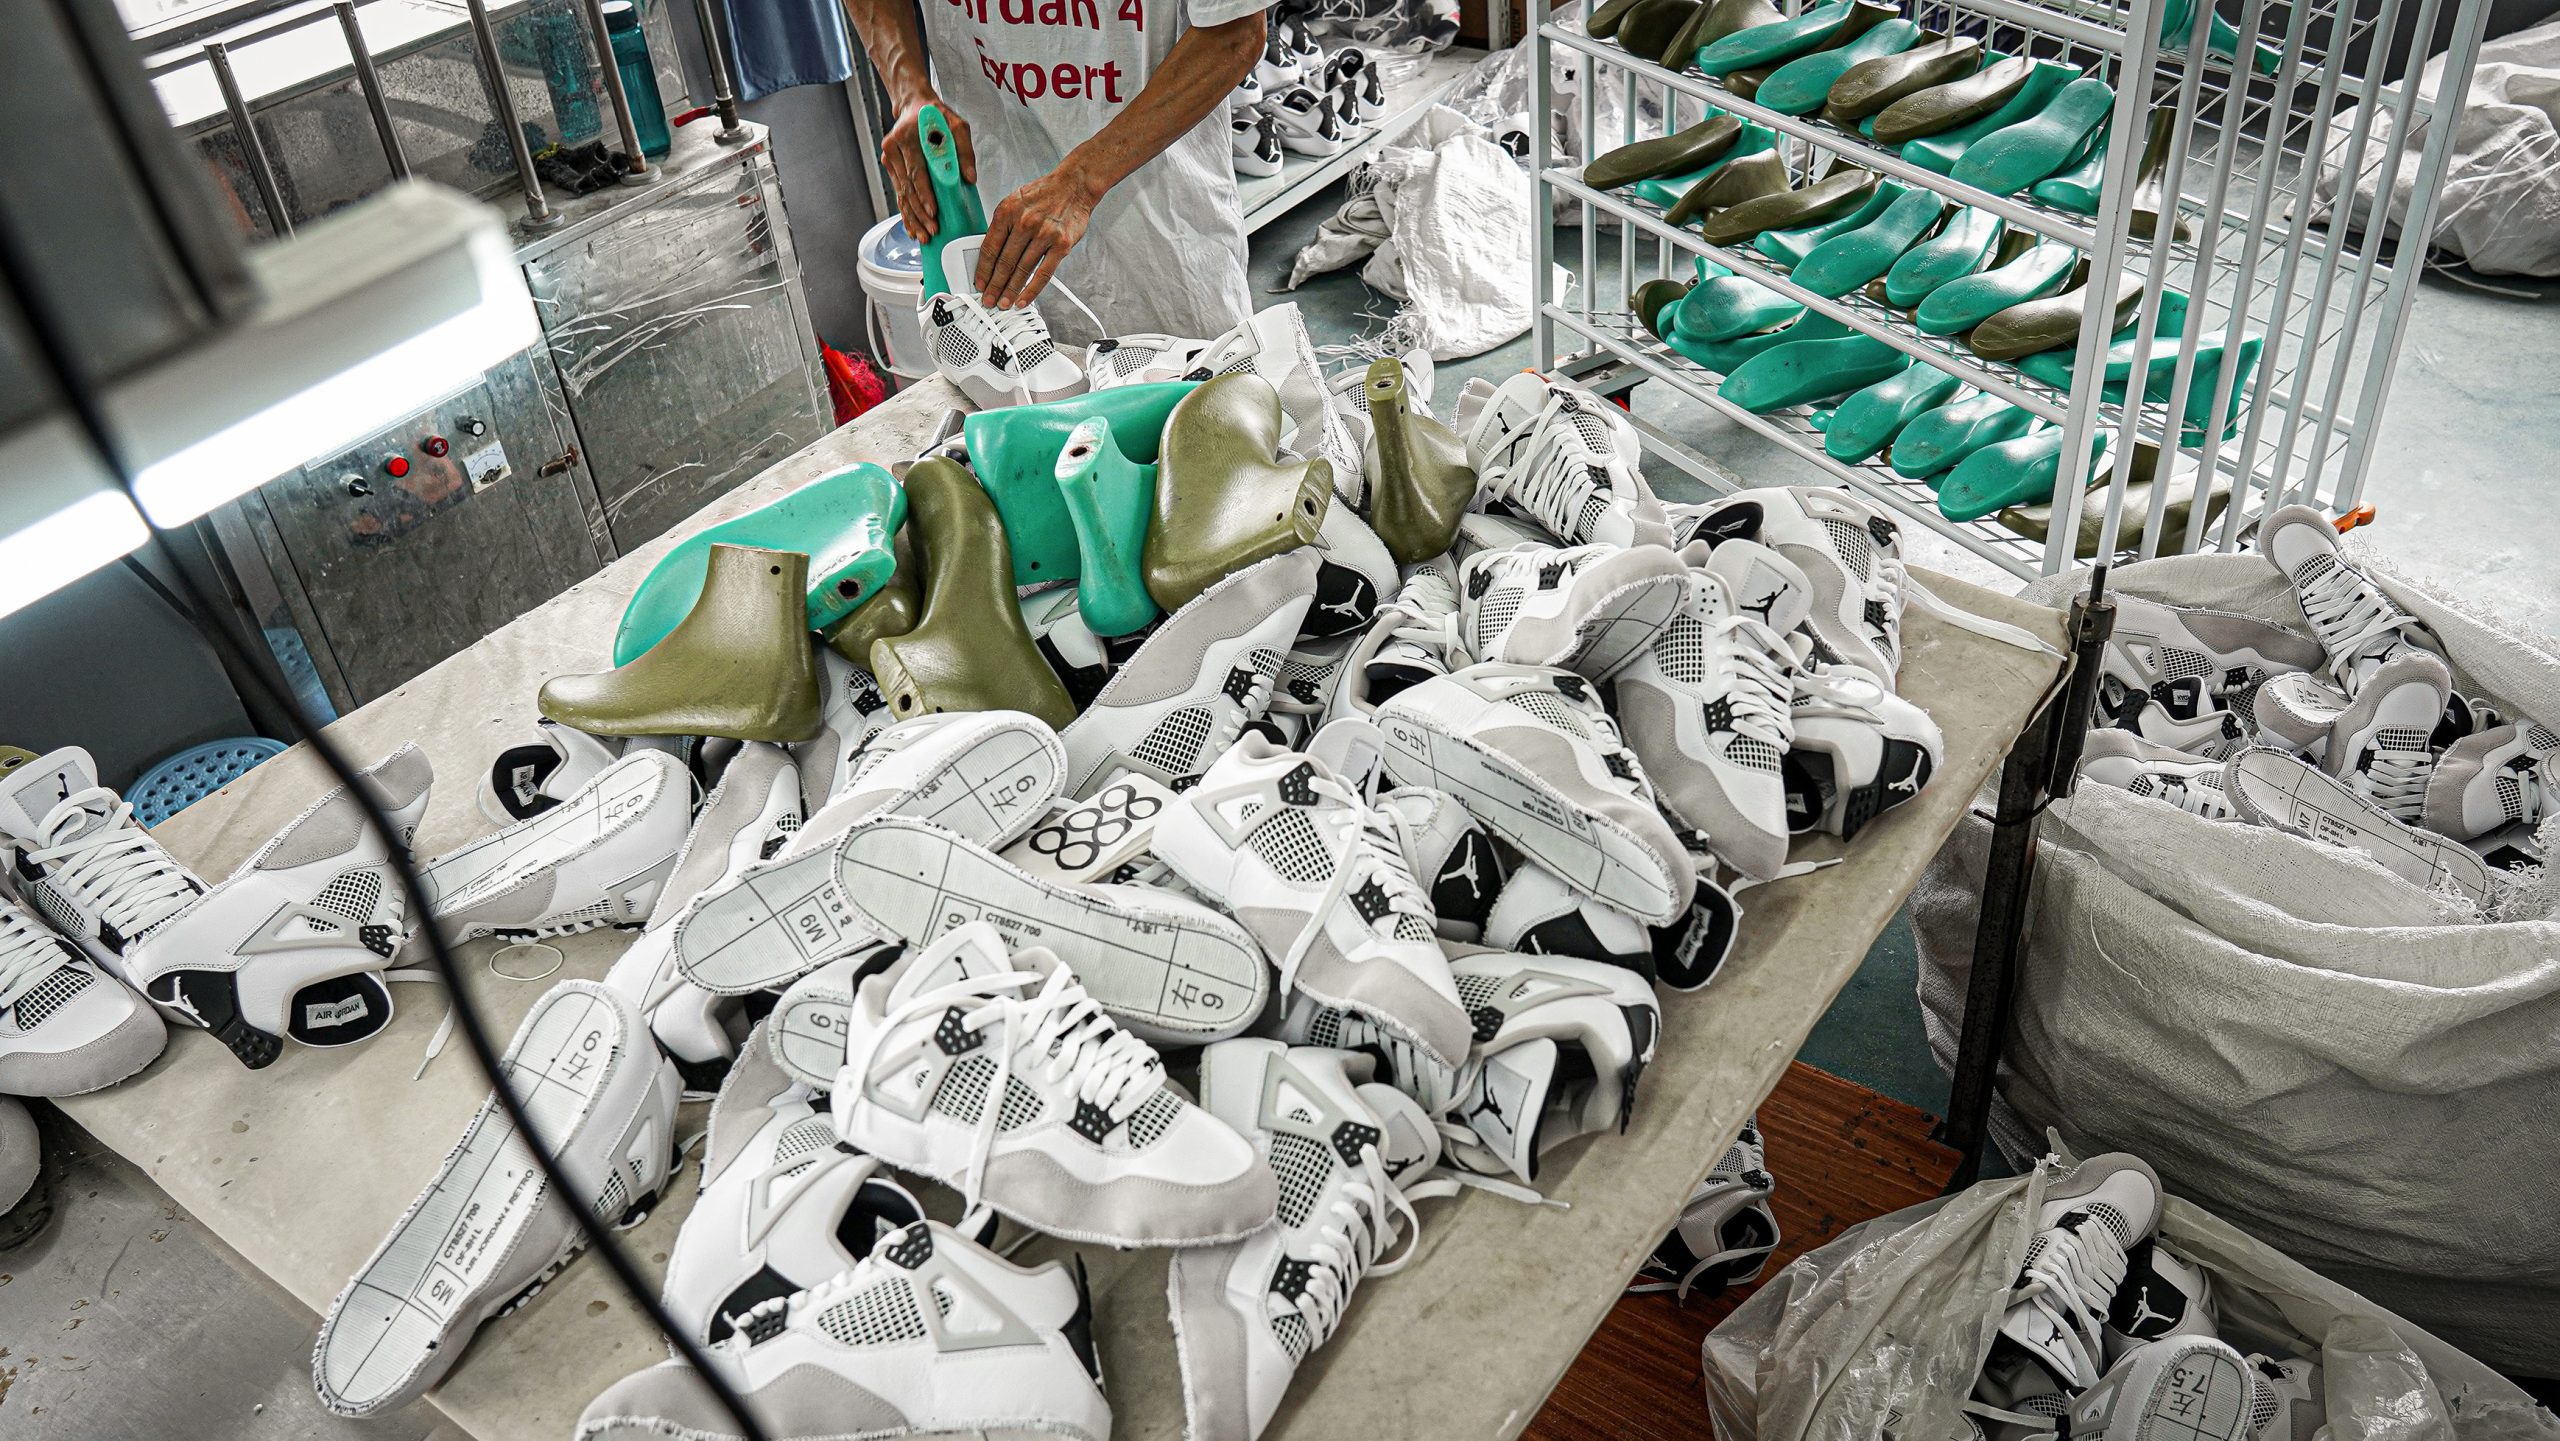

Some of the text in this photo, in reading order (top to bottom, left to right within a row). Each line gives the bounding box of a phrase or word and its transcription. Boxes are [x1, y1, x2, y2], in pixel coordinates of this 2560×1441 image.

[952, 0, 1143, 32] rdan 4
[974, 36, 1123, 108] Expert
[989, 786, 1018, 814] 右
[801, 915, 827, 943] M9
[985, 912, 1022, 932] CT8527
[1171, 978, 1200, 1011] 右
[314, 1010, 333, 1021] AIR
[561, 1052, 593, 1080] 右
[477, 1212, 506, 1257] JORDAN
[508, 1168, 535, 1206] RETRO
[2172, 1368, 2205, 1395] 7.5
[2169, 1391, 2196, 1416] 左
